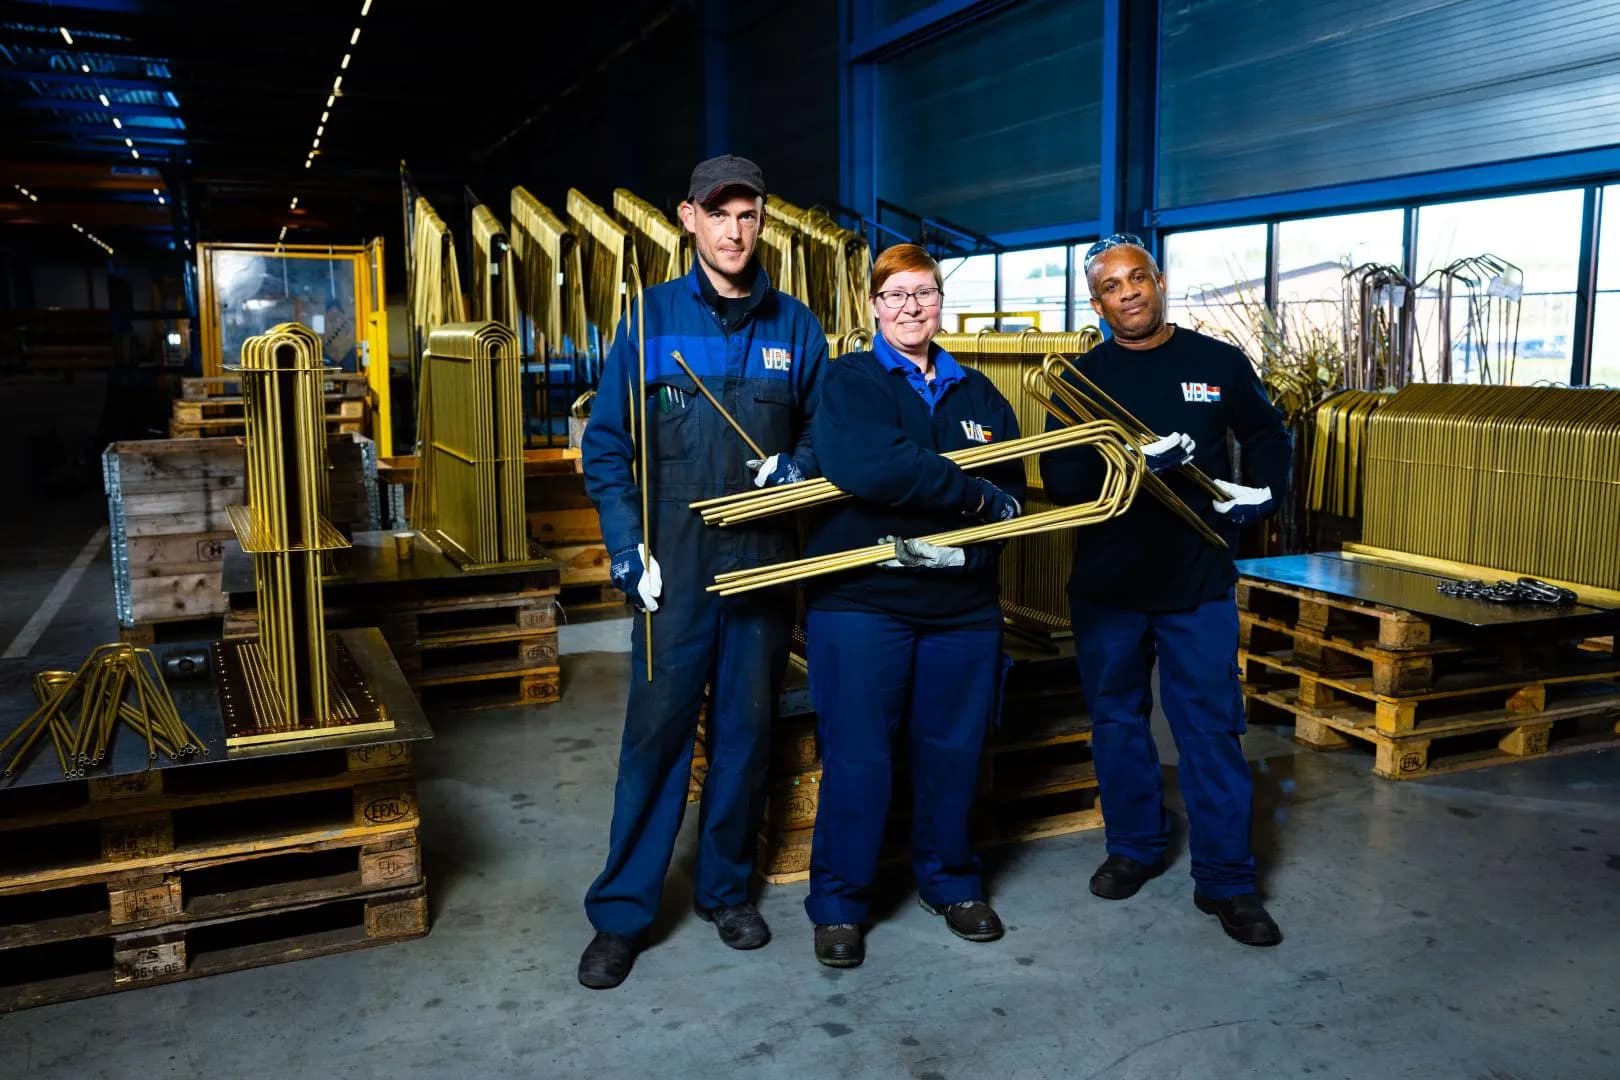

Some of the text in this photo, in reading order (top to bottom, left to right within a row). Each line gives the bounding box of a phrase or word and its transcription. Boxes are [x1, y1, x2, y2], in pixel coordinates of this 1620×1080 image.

[761, 347, 790, 371] VDL
[1180, 381, 1212, 403] VDL
[1403, 756, 1422, 769] EPAL
[371, 801, 404, 819] EPAL
